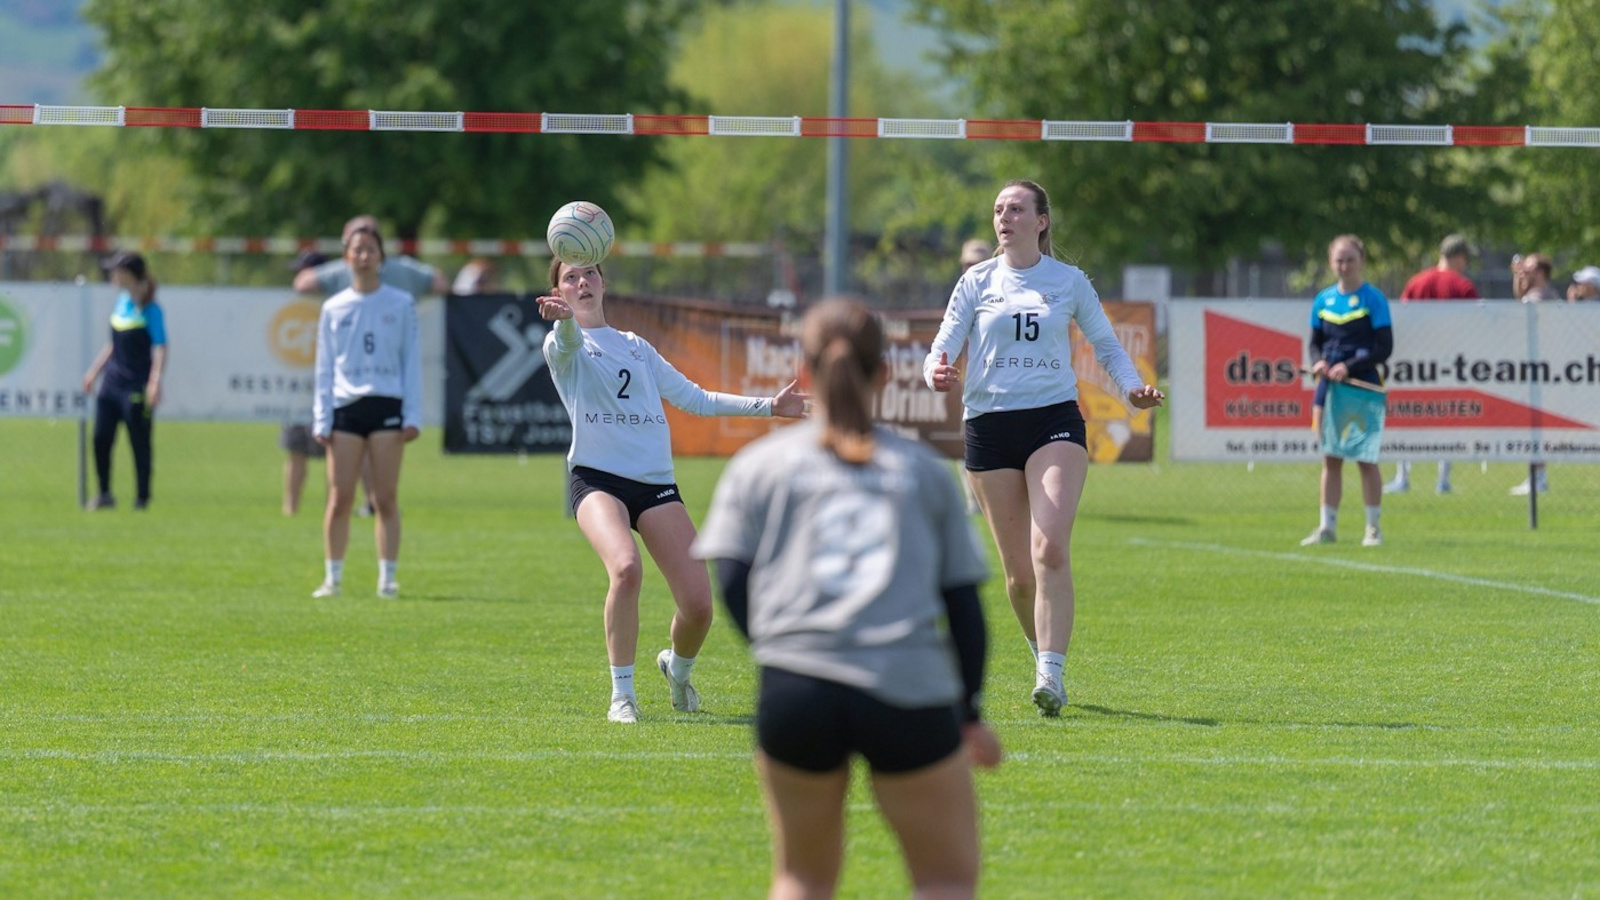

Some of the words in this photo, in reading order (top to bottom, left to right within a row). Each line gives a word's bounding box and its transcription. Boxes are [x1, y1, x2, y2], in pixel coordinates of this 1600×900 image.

[1012, 312, 1040, 342] 15
[364, 331, 375, 355] 6
[983, 357, 1061, 370] MERBAG
[616, 368, 632, 400] 2
[585, 413, 667, 426] MERBAG
[656, 488, 675, 499] JAKO
